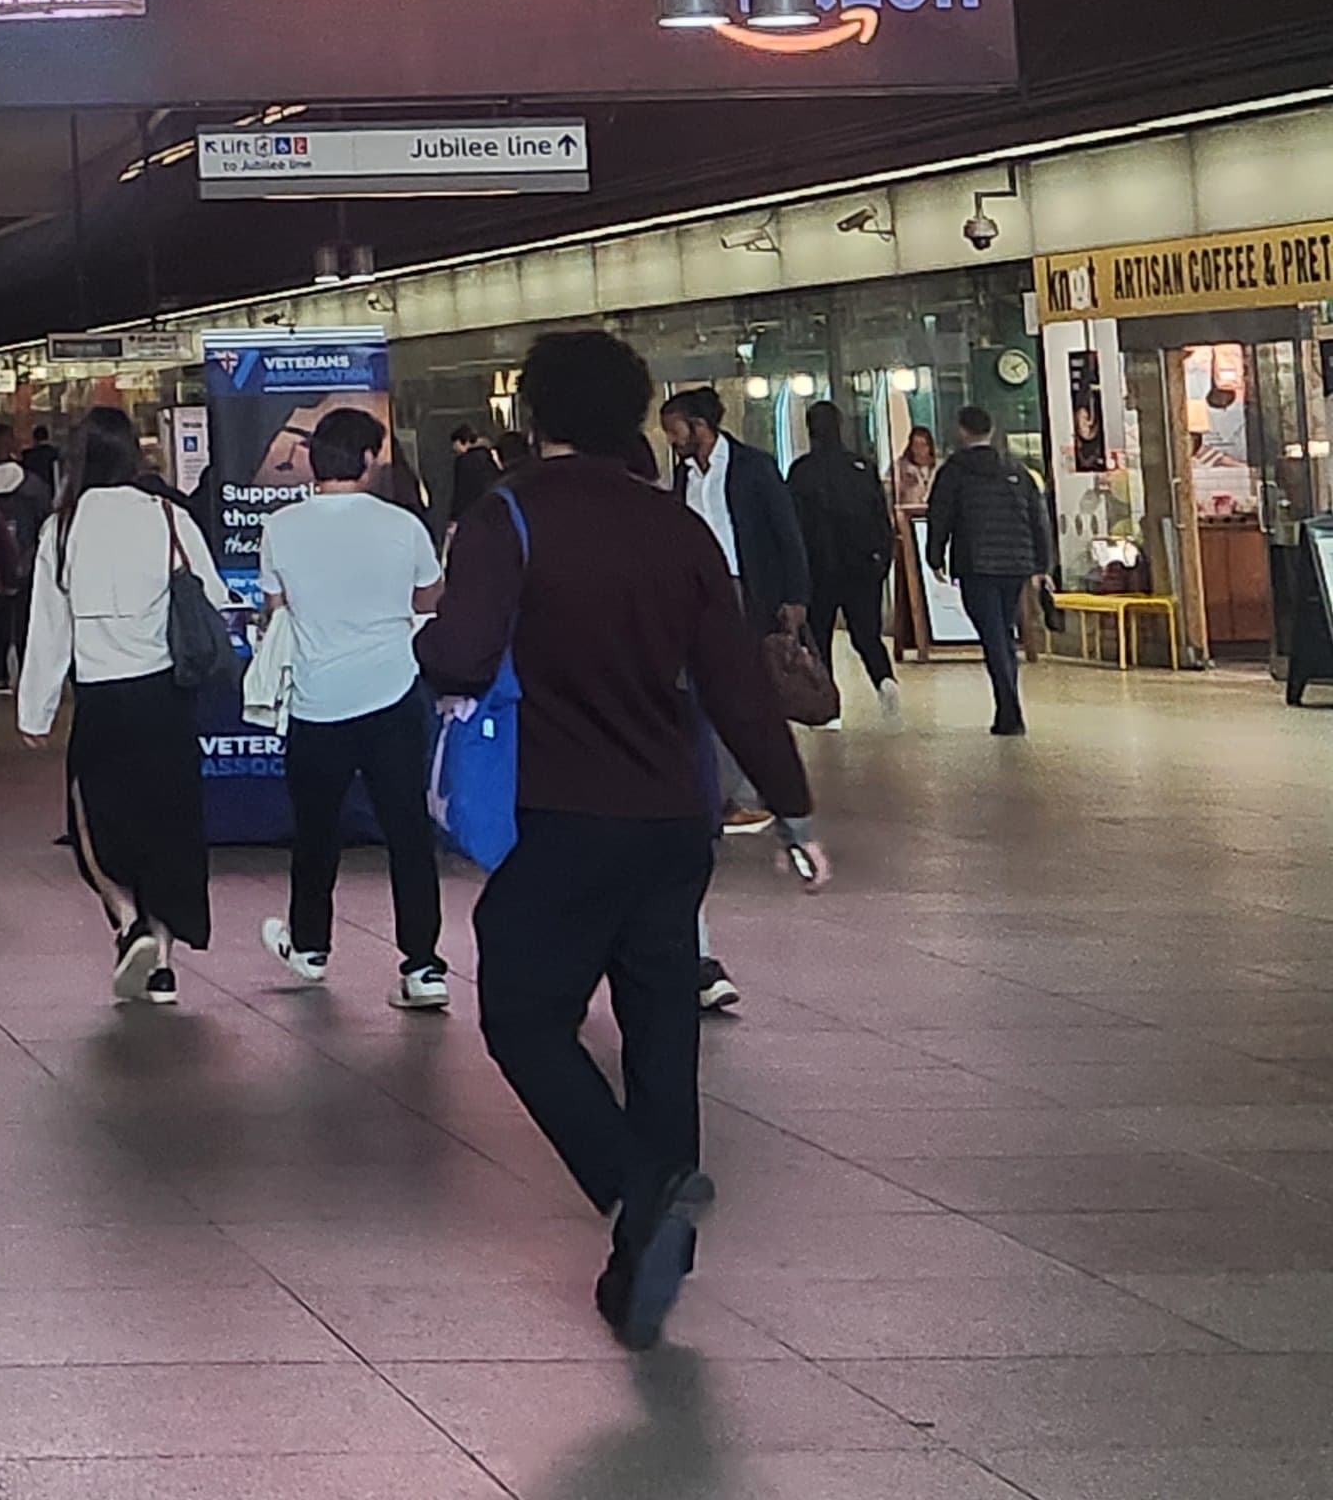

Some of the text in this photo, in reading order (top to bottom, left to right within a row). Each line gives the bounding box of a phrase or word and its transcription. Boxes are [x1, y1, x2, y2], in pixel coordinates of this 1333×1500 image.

[222, 132, 553, 160] Lift Jubilee line
[223, 157, 312, 172] to Jubilee line
[1114, 252, 1183, 300] ARTISAN
[1188, 244, 1258, 294] COFFEE
[1263, 241, 1277, 286] &
[264, 354, 350, 370] VETERANS
[265, 368, 374, 383] ASSOCIATION
[222, 482, 321, 505] Supporti
[197, 734, 287, 756] VETER
